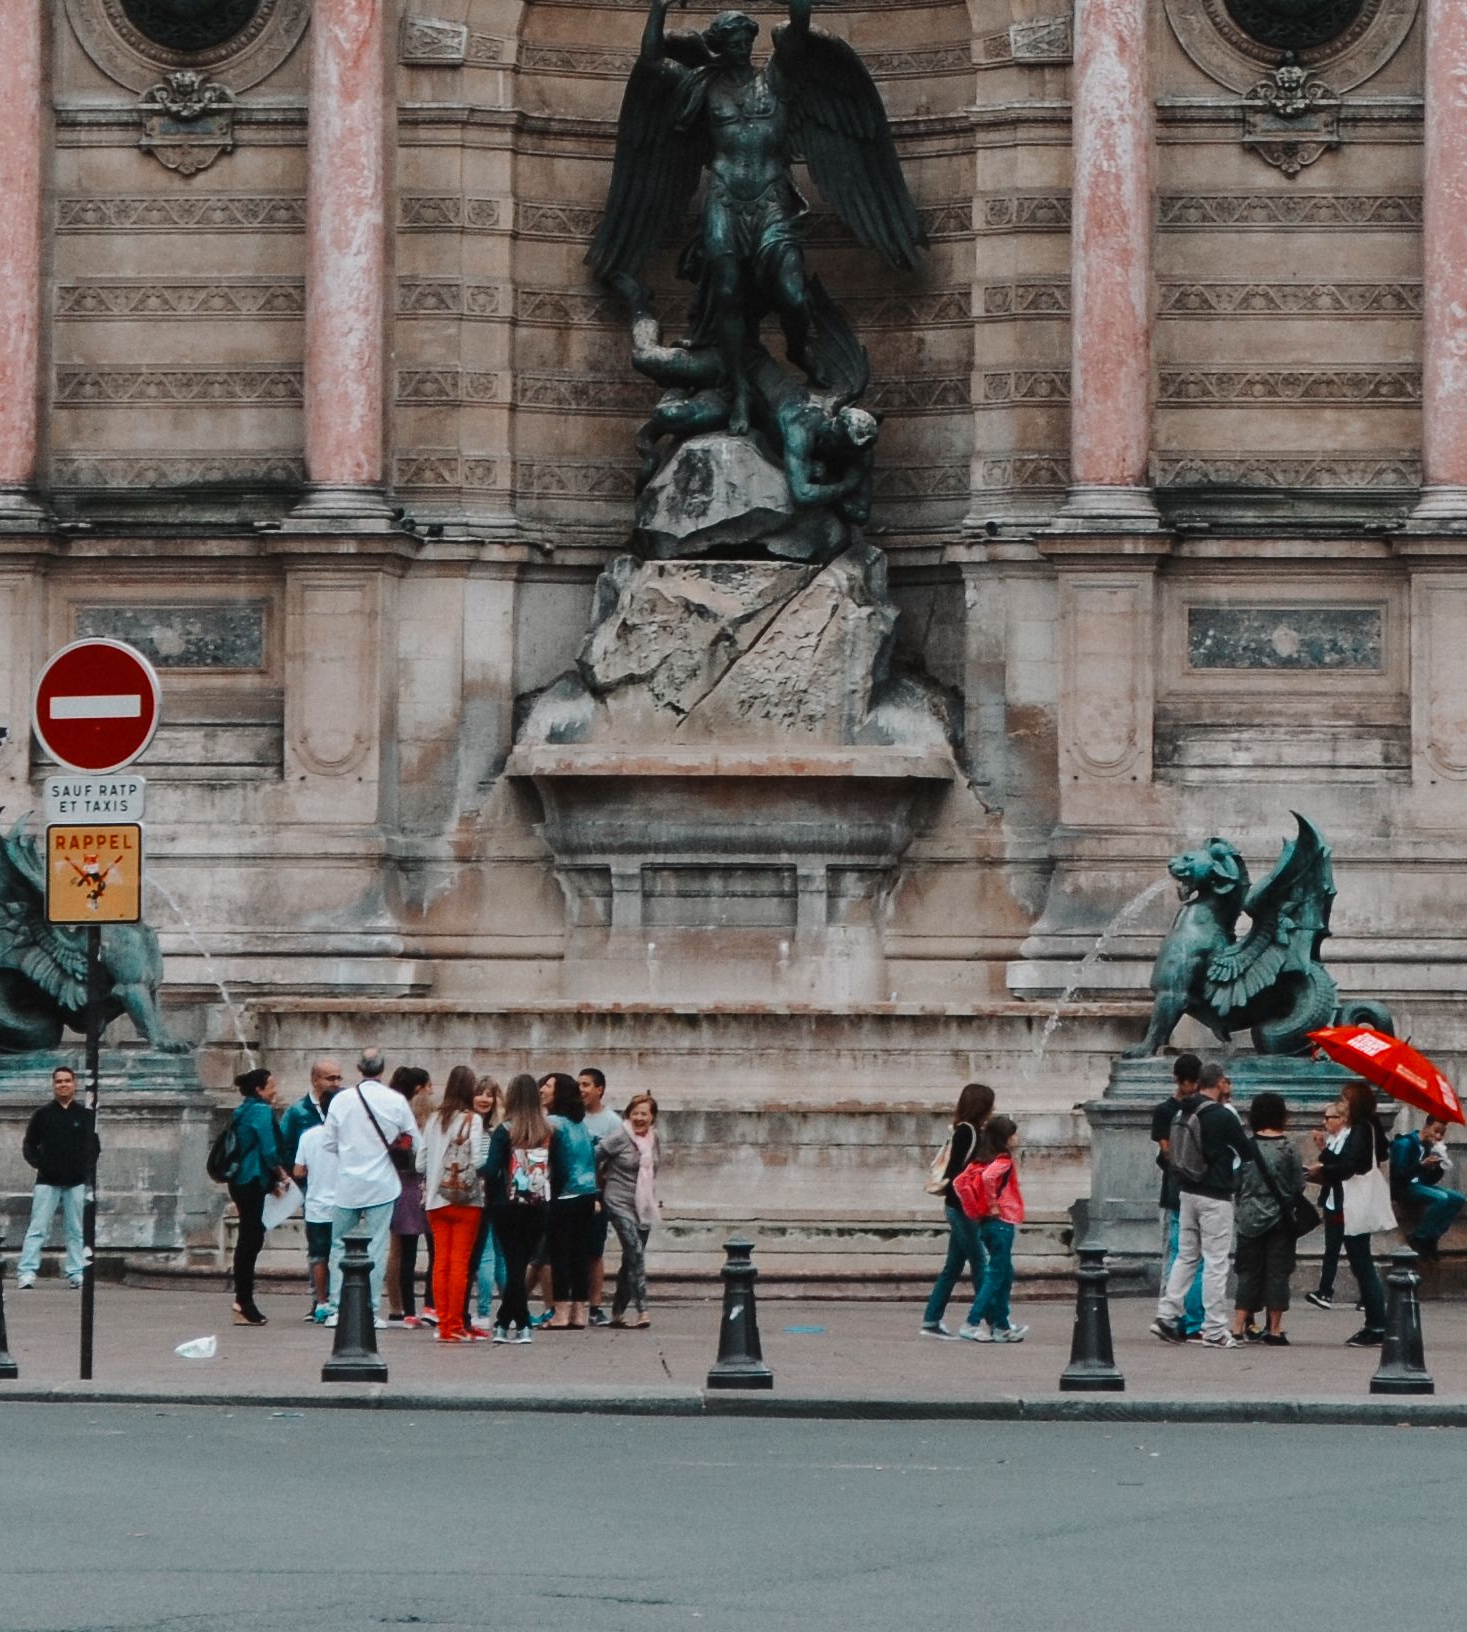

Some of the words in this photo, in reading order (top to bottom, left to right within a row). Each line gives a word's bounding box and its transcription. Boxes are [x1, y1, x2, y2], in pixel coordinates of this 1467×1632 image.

[51, 784, 93, 798] SAUF
[98, 783, 137, 796] RATP
[59, 800, 77, 813] ET
[85, 799, 129, 813] TAXIS
[55, 834, 133, 850] RAPPEL
